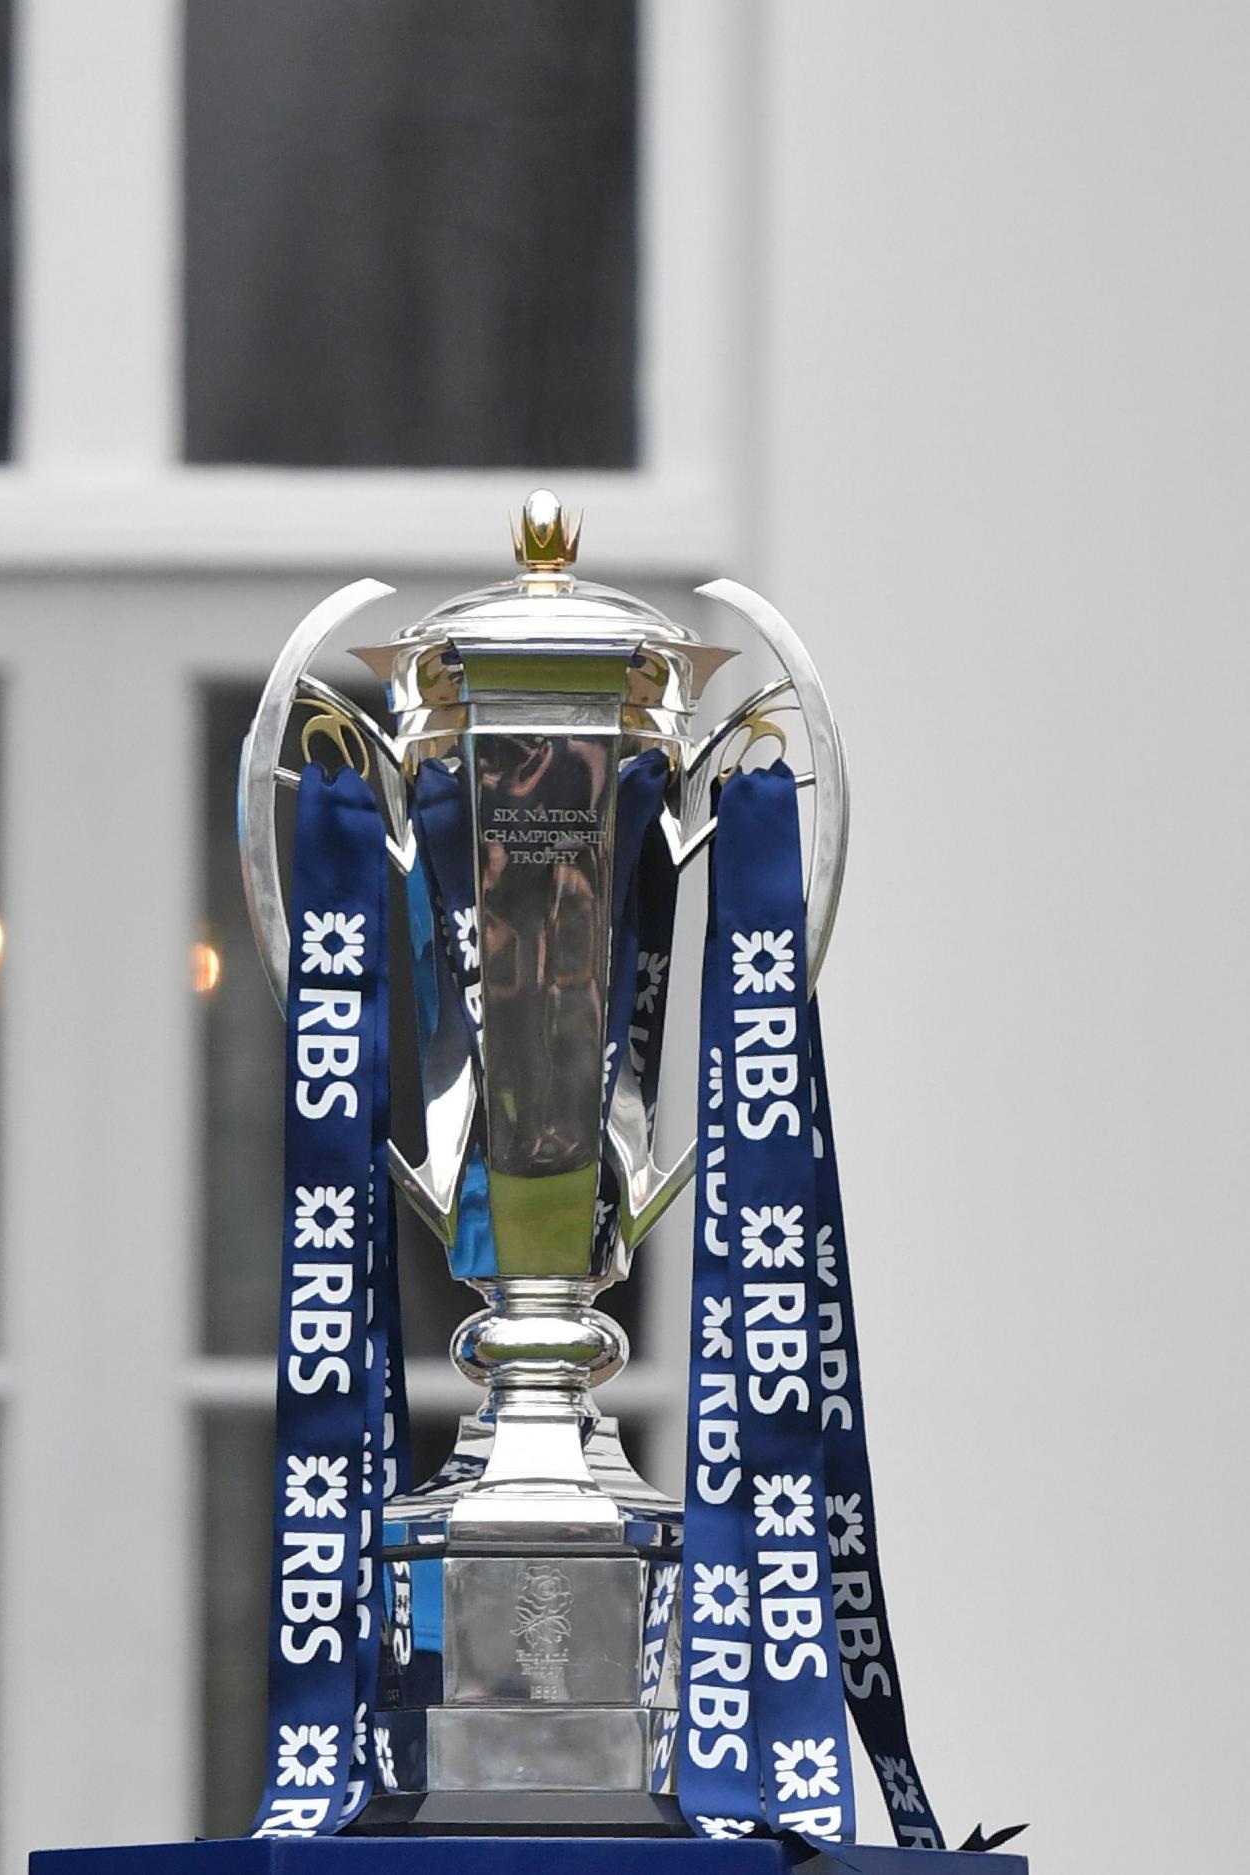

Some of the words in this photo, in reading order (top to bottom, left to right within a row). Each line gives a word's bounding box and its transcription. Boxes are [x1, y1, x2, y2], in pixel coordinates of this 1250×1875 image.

[493, 808, 519, 822] SIX
[524, 809, 598, 823] NATIONS
[510, 850, 578, 864] TROPHY
[295, 988, 362, 1120] RBS
[734, 1007, 801, 1141] RBS
[288, 1263, 353, 1395] RBS
[743, 1282, 810, 1415] RBS
[280, 1532, 345, 1664] RBS
[757, 1551, 828, 1681] RBS
[832, 1571, 891, 1699] RBS
[688, 1637, 751, 1773] RBS
